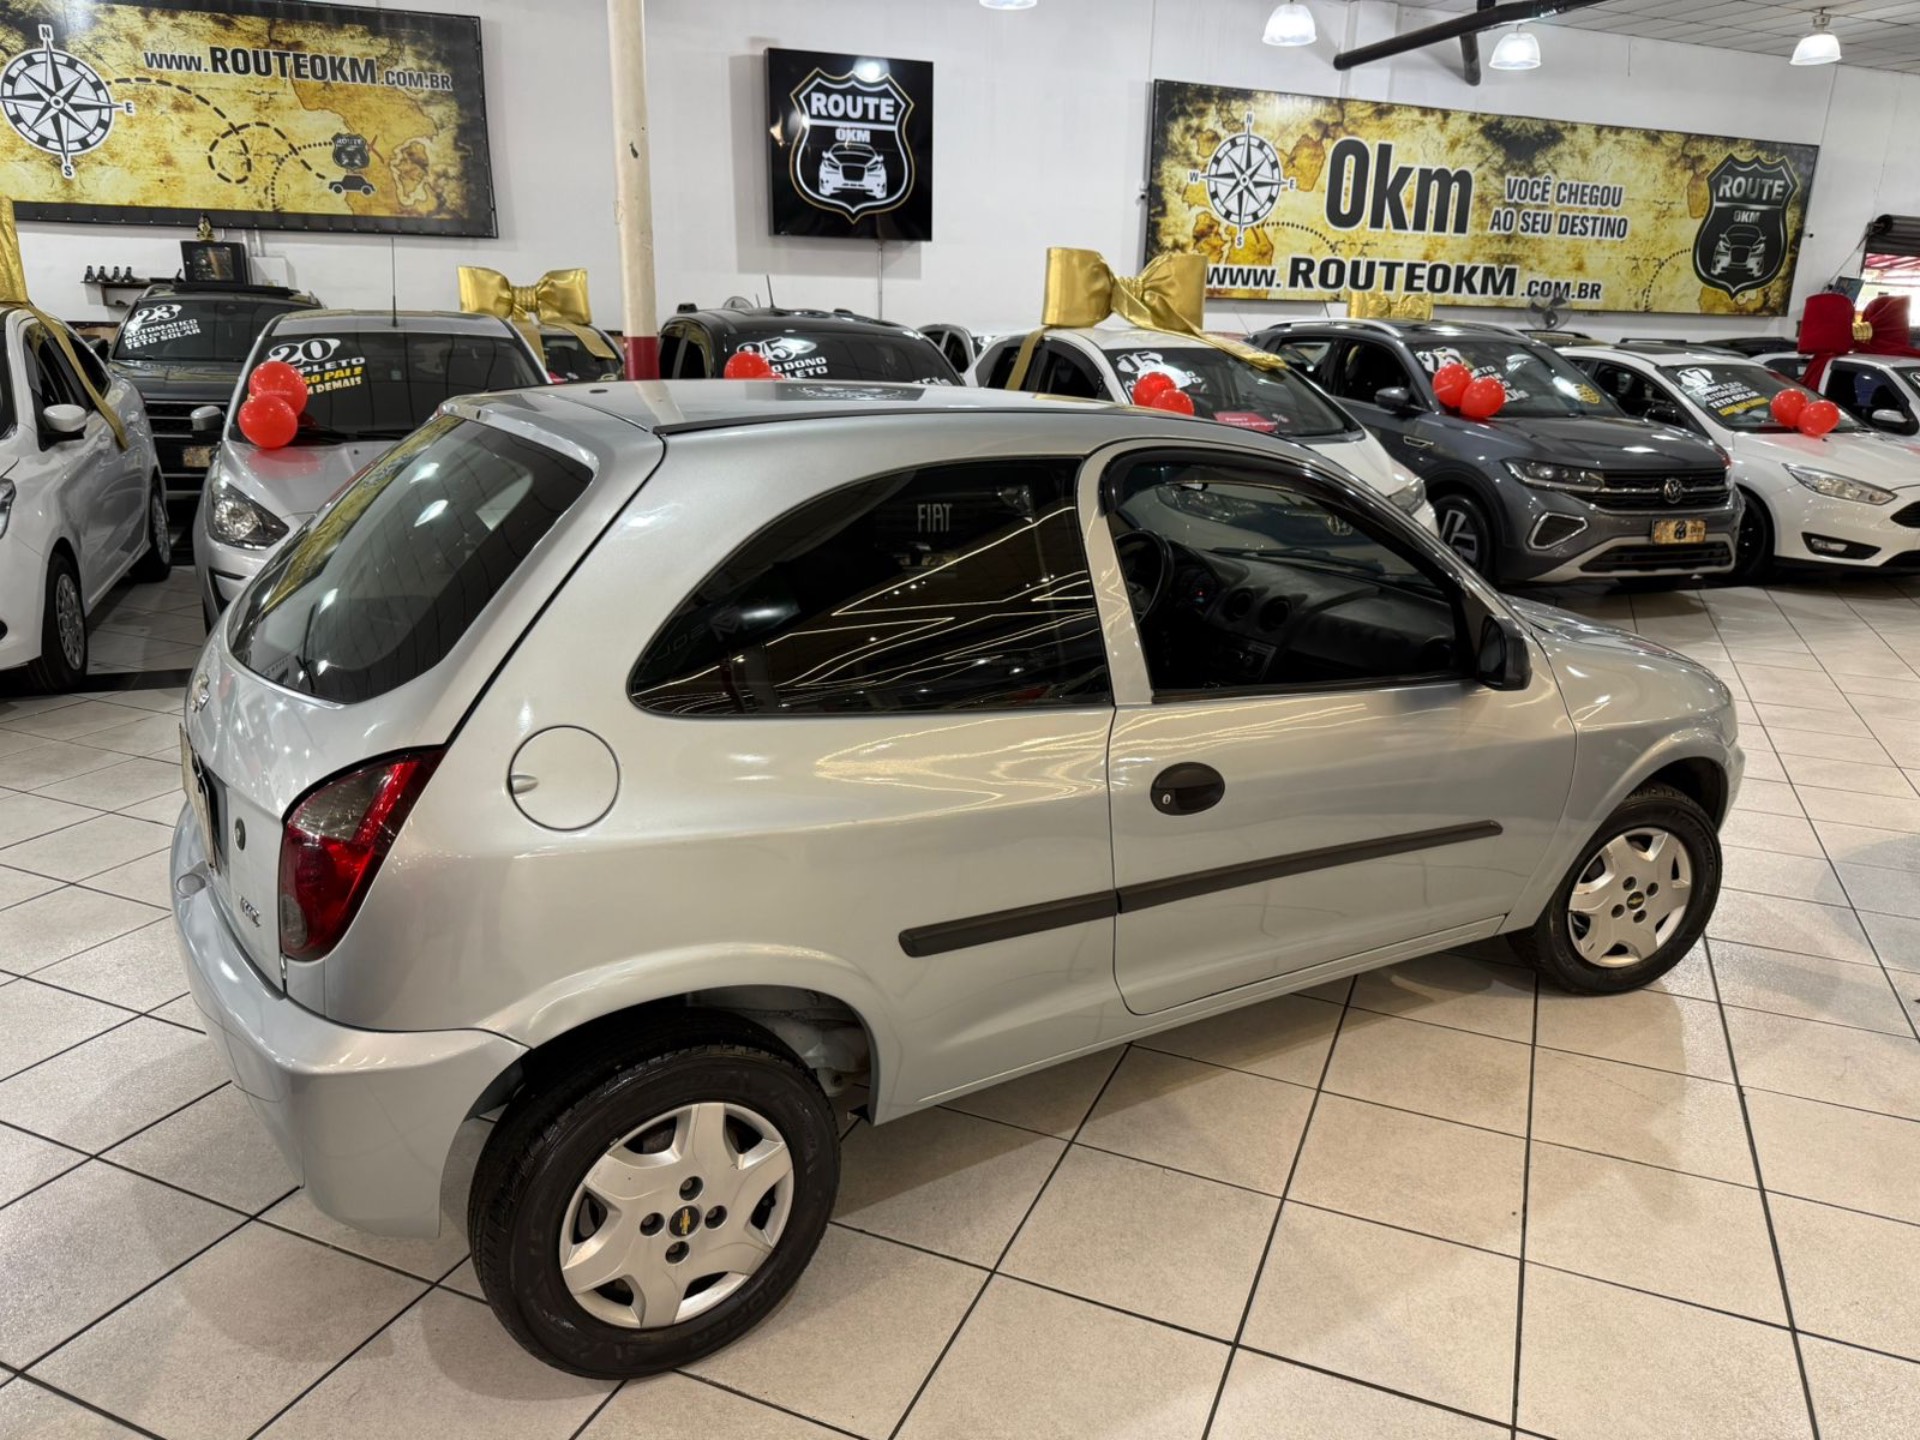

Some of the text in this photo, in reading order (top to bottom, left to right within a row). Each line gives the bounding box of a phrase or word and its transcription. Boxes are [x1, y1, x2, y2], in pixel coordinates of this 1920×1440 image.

[41, 26, 51, 38] N
[125, 102, 133, 113] E
[810, 92, 895, 122] ROUTE
[1246, 114, 1253, 124] N
[64, 165, 73, 177] S
[1189, 172, 1199, 182] W
[1289, 179, 1295, 190] E
[1326, 138, 1473, 235] 0km
[1506, 175, 1623, 208] VOCÊ CHEGOU
[1718, 175, 1785, 201] ROUTE
[1490, 210, 1628, 239] AO SEU DESTINO
[1236, 236, 1243, 246] S
[136, 304, 178, 325] 23
[126, 328, 201, 350] TETO SOLAR
[269, 338, 333, 367] 20
[300, 356, 366, 373] PLETO
[783, 356, 828, 370] DONO
[315, 376, 362, 393] DEMAIS
[917, 503, 954, 533] FIAT
